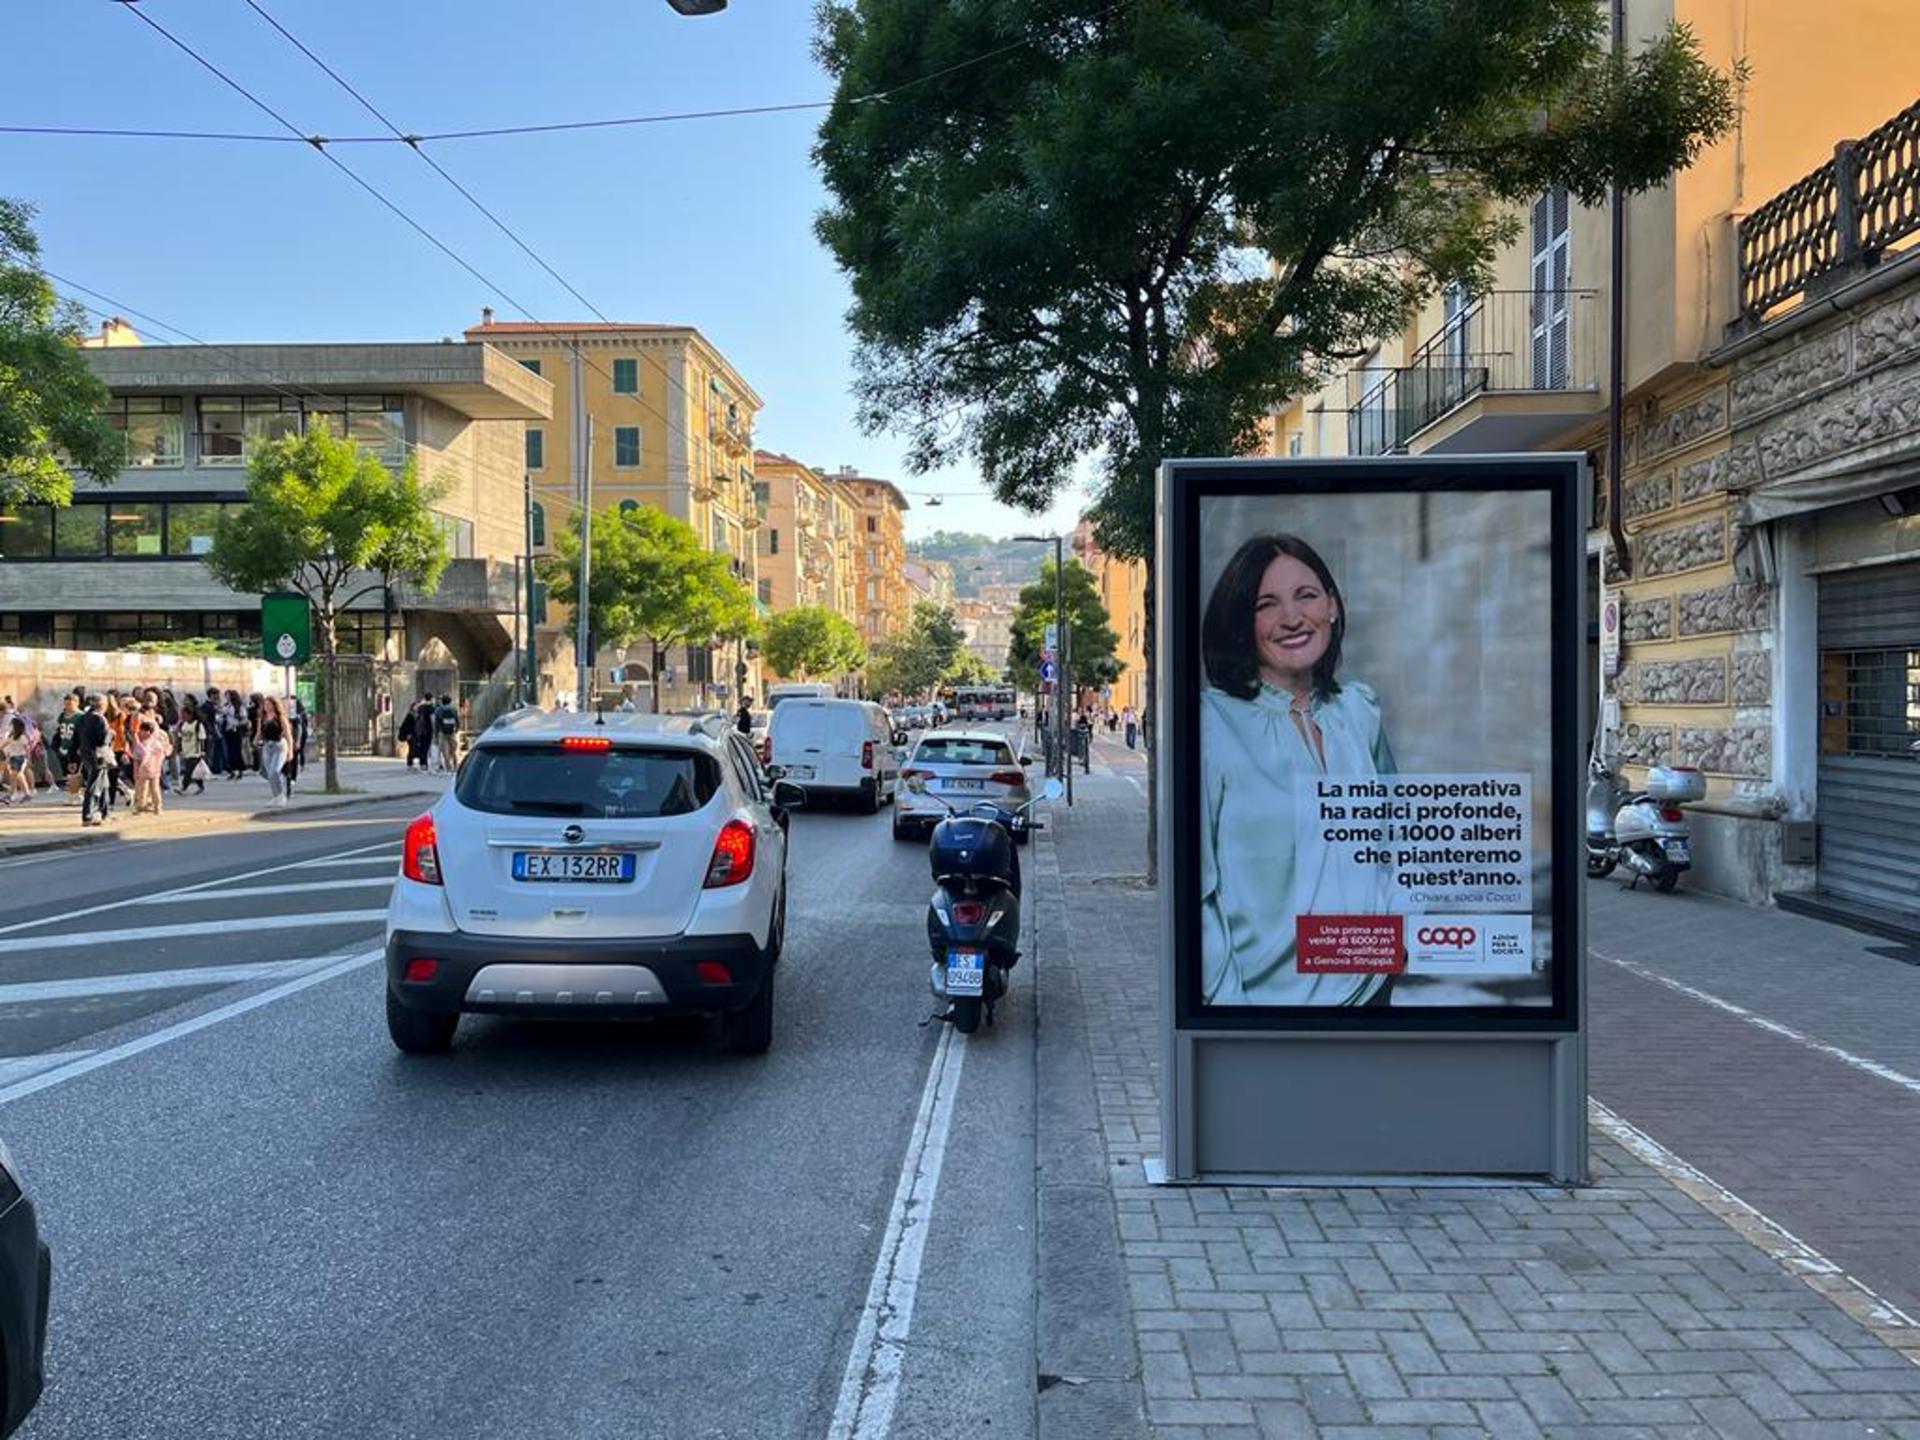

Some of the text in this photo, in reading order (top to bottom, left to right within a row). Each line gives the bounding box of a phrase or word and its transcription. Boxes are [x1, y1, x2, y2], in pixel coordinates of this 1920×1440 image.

[1317, 780, 1522, 800] La mia cooperativa
[1320, 802, 1522, 822] ha radici profonde,
[1323, 824, 1522, 841] come i 1000 alberi
[527, 856, 620, 876] EX 132RR
[1354, 847, 1522, 867] che pianteremo
[1397, 869, 1522, 889] quest'anno.
[1308, 935, 1337, 946] verde
[1338, 935, 1349, 946] di
[1350, 935, 1379, 946] 6000
[1320, 926, 1396, 938] Una prima area
[1417, 926, 1476, 950] coop
[1305, 957, 1312, 966] a
[1313, 956, 1351, 966] Genova
